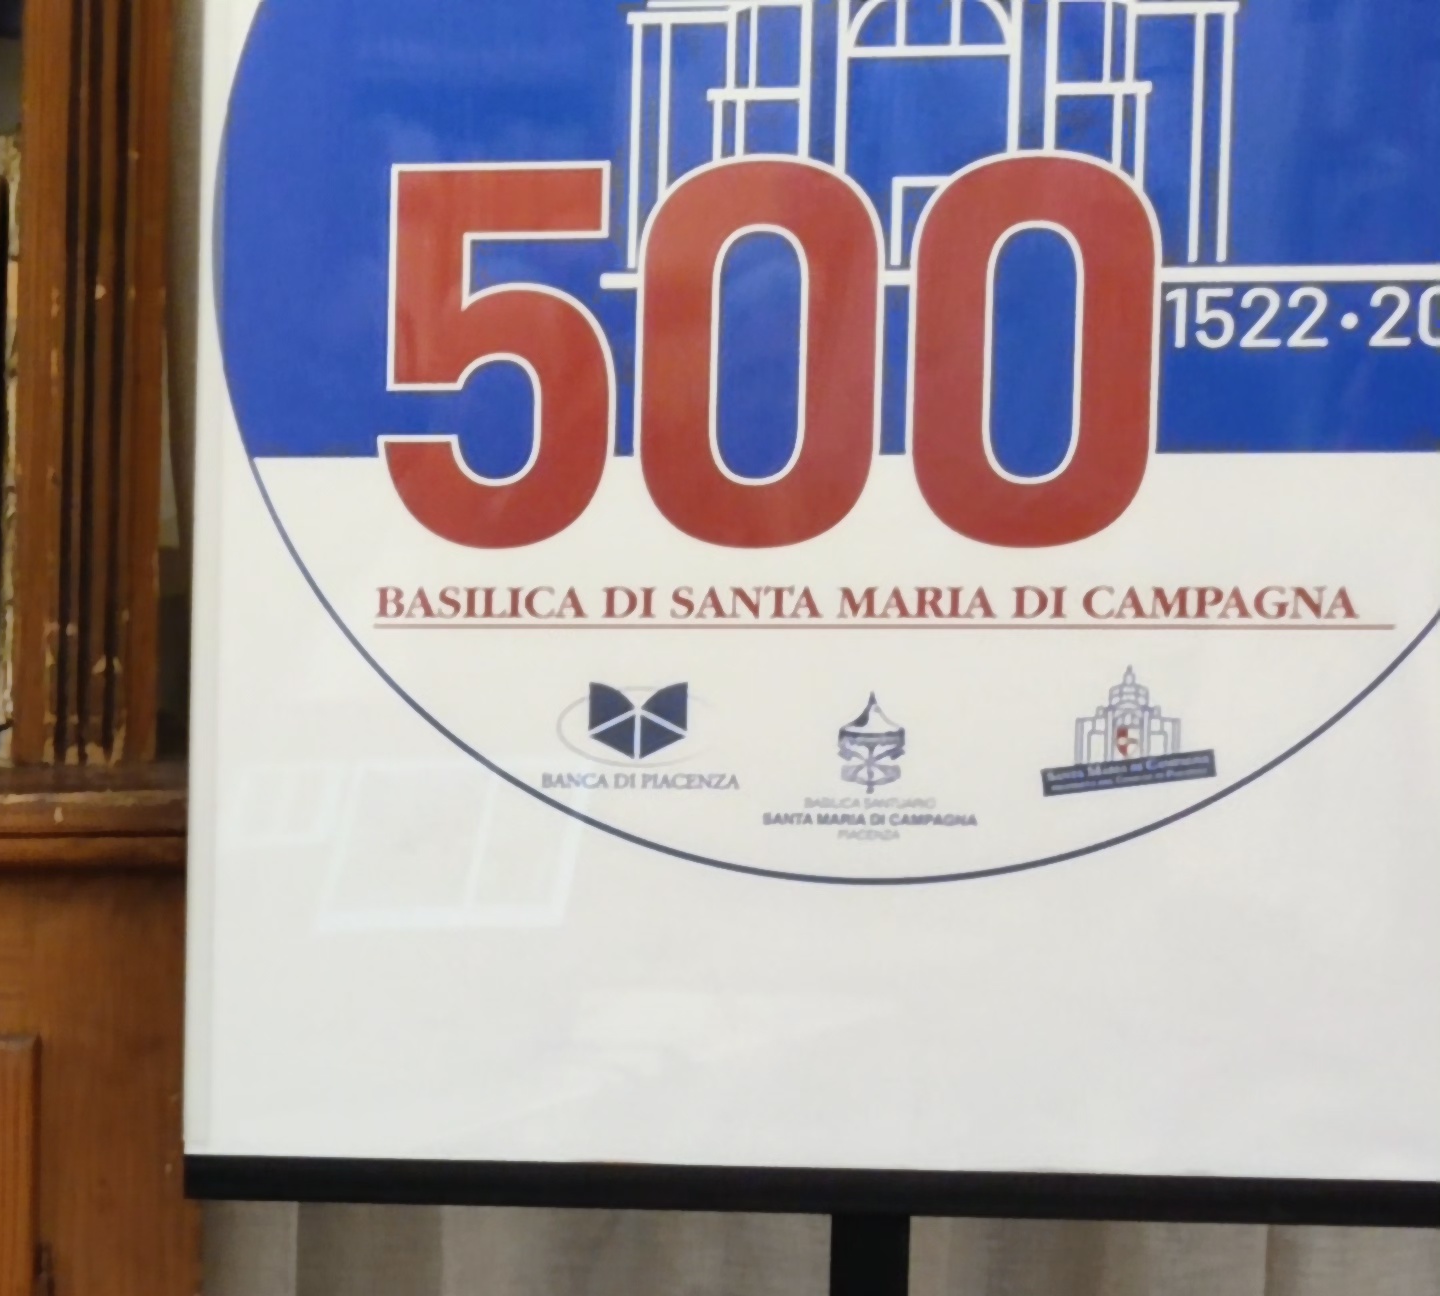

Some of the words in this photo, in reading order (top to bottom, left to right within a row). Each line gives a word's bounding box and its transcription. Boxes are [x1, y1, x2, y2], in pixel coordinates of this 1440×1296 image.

[376, 150, 1163, 549] 500
[374, 585, 588, 619] BASILICA
[601, 585, 658, 619] DI
[669, 585, 824, 619] SANTA
[835, 585, 997, 619] MARIA
[1010, 585, 1068, 619] DI
[1081, 585, 1360, 619] CAMPAGNA
[541, 772, 609, 790] BANCA
[613, 773, 636, 790] DI
[640, 773, 740, 791] PIACENZA
[762, 812, 814, 826] SANTA
[816, 812, 867, 826] MARIA
[869, 812, 886, 826] DI
[888, 812, 979, 827] CAMPAGNA
